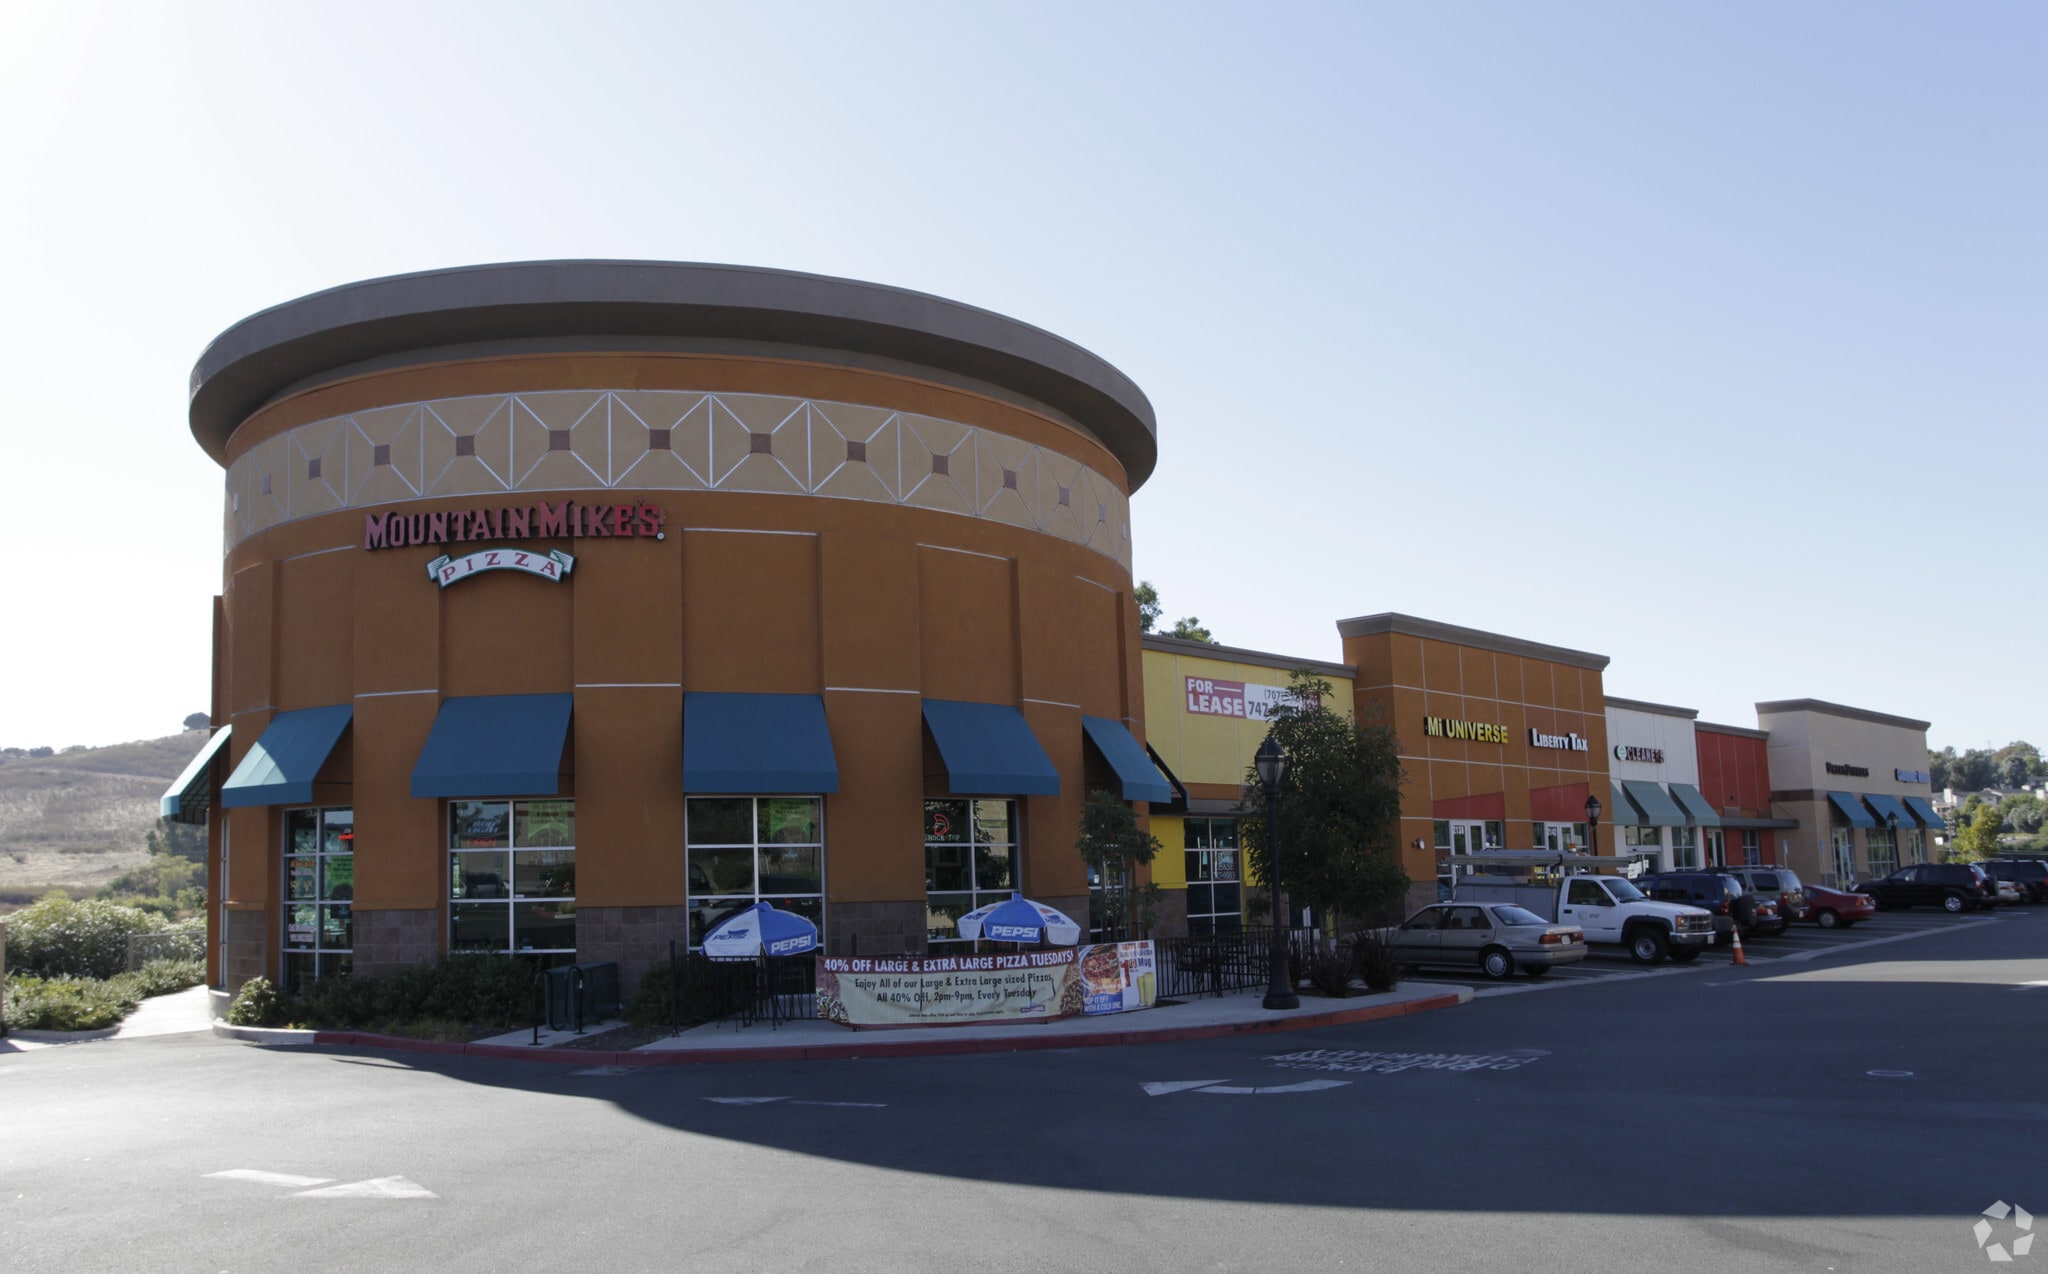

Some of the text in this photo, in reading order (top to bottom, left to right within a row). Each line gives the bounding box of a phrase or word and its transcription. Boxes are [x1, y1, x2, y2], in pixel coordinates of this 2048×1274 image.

[364, 506, 533, 550] MOUNTAIN
[440, 552, 557, 582] PIZZA
[1187, 678, 1213, 694] FOR
[1187, 693, 1243, 716] LEASE
[1445, 719, 1509, 744] UNIVERSE
[1531, 727, 1588, 752] LIBERTY TAX
[991, 925, 1040, 938] PEPSI
[770, 935, 812, 954] PEPSI
[824, 950, 1074, 972] 40% OFF LARGE & EXTRA LARGE PIZZA TUESDAYS!
[855, 979, 876, 991] Enjoy
[879, 978, 891, 988] All
[893, 978, 901, 988] of
[904, 980, 917, 988] our
[920, 978, 943, 990] Large
[946, 977, 953, 987] &
[955, 977, 977, 986] Extra
[979, 975, 1002, 988] Large
[1005, 974, 1025, 984] sized
[876, 992, 888, 1002] All
[890, 992, 911, 1003] 40%
[934, 991, 975, 1003] 2pm-9pm,
[977, 990, 1001, 1001] Every
[1004, 989, 1037, 1001] Tuesday
